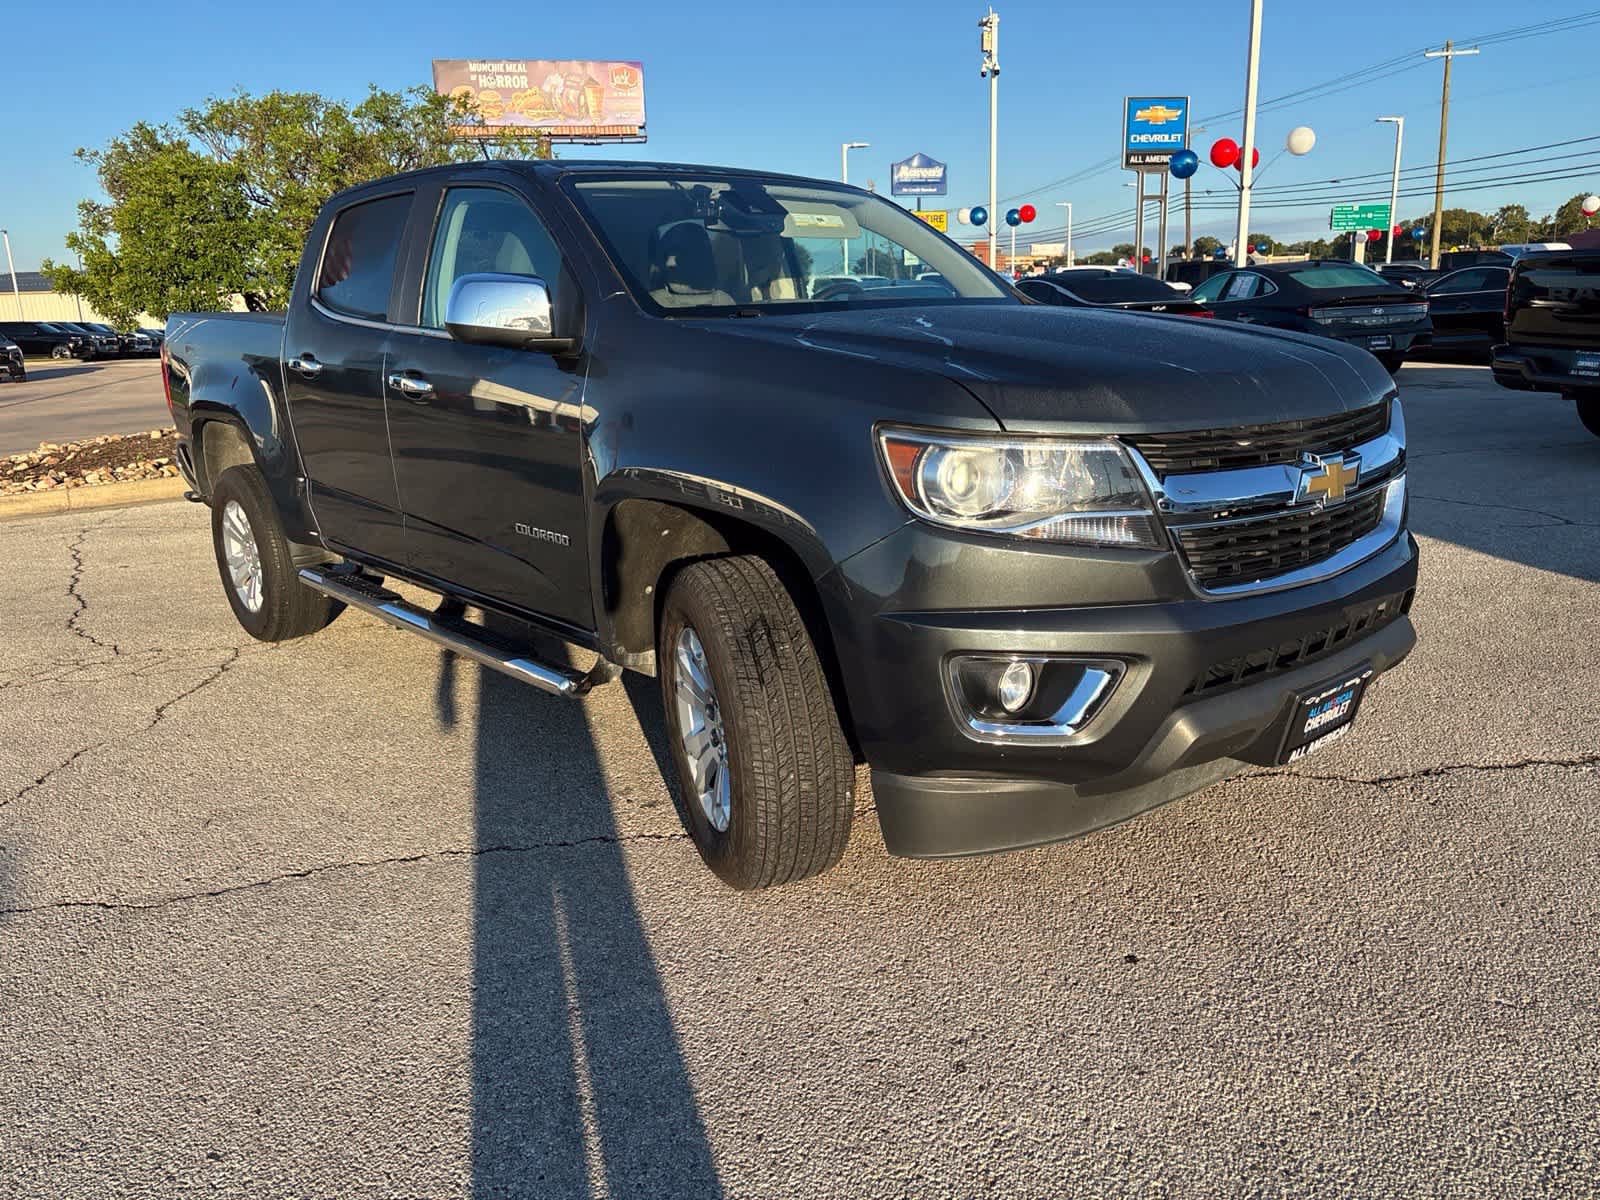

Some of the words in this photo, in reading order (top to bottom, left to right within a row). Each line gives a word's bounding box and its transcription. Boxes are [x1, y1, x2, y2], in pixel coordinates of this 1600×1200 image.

[505, 63, 527, 73] MEAL
[1130, 134, 1182, 143] CHEVROLET
[1130, 155, 1144, 163] ALL
[1145, 154, 1172, 163] AMERIC
[515, 522, 569, 546] COLORADO
[1304, 699, 1352, 733] CHEVROLET
[1308, 706, 1321, 719] ALL
[1288, 745, 1307, 764] ALL
